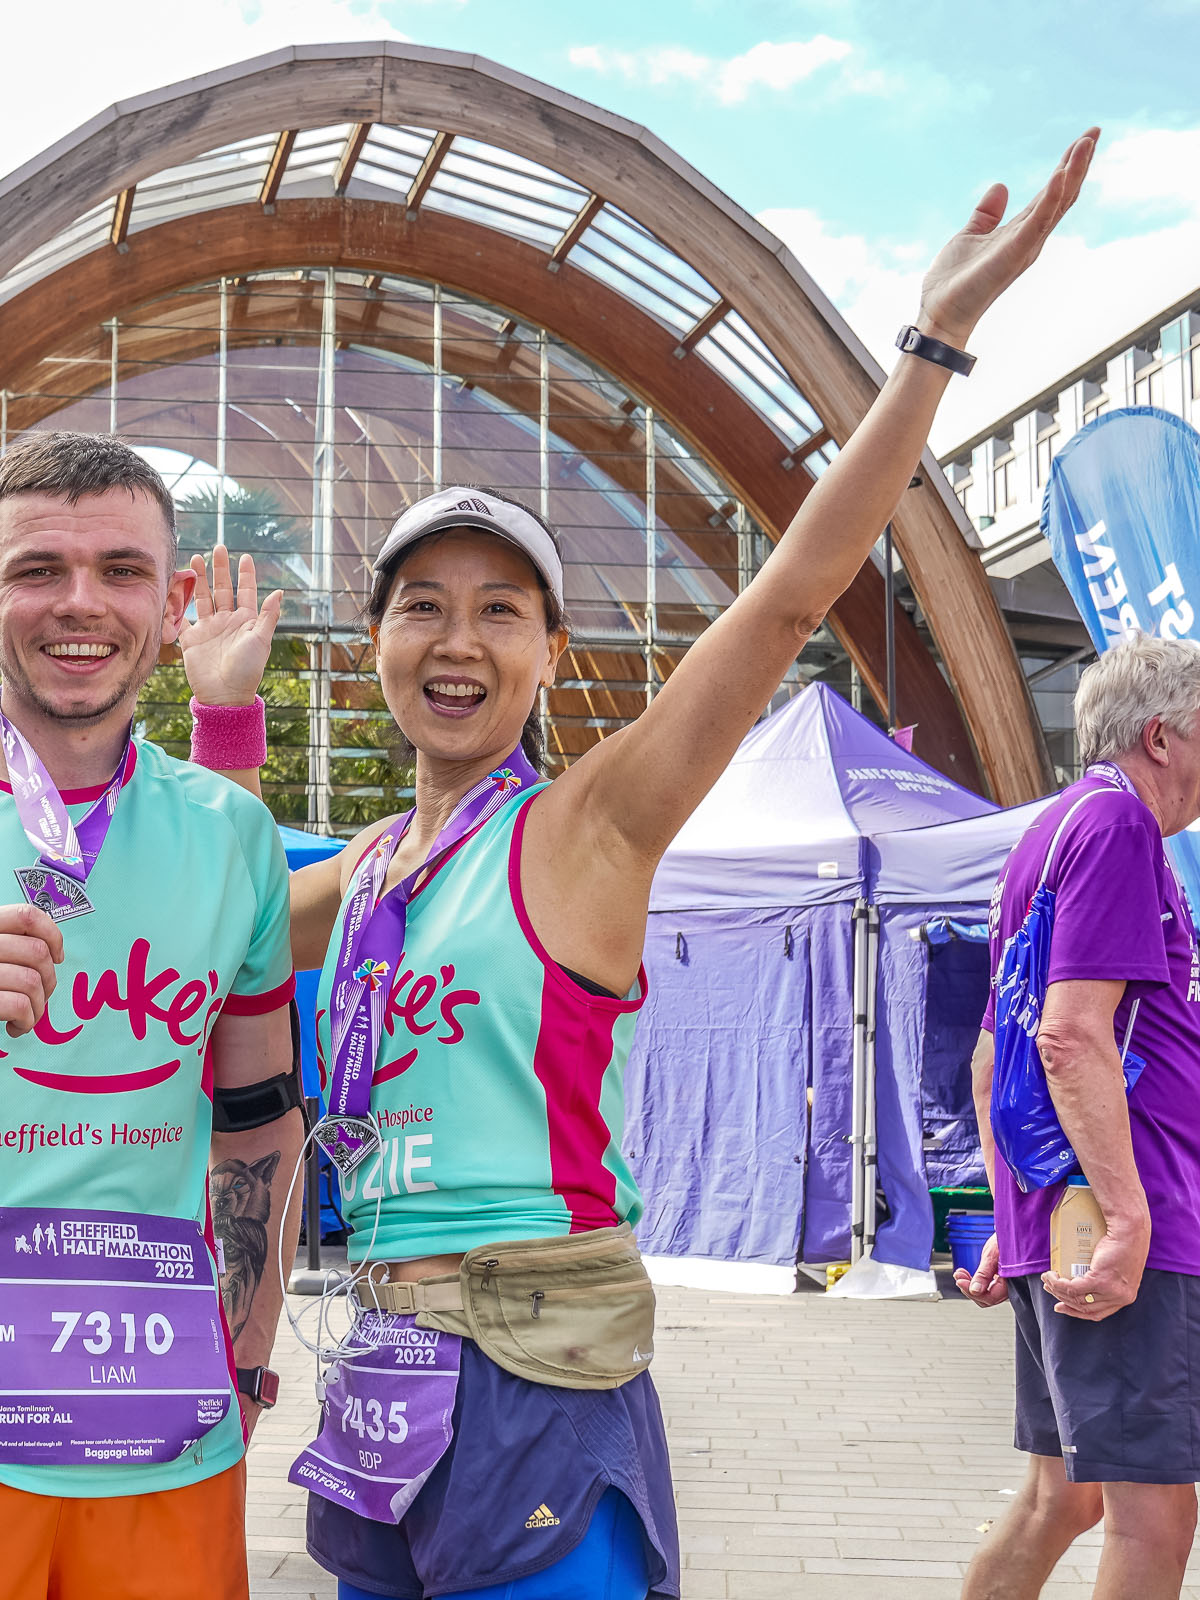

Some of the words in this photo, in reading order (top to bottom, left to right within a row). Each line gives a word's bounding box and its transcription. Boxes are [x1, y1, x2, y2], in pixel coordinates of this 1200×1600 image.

[351, 894, 362, 915] HALF
[354, 892, 369, 932] SHEFFIELD
[342, 917, 356, 968] MARATHON
[348, 1031, 359, 1058] HALF
[351, 1033, 367, 1080] SHEFFIELD
[338, 1056, 355, 1115] MARATHON
[377, 1103, 434, 1130] Hospice
[110, 1121, 183, 1151] Hospice
[63, 1222, 136, 1240] SHEFFIELD
[63, 1240, 104, 1256] HALF
[107, 1241, 191, 1260] MARATHON
[155, 1261, 195, 1279] 2022
[0, 1325, 15, 1342] M
[50, 1311, 175, 1355] 7310
[394, 1347, 436, 1365] 2022
[89, 1365, 137, 1384] LIAM
[197, 1399, 222, 1407] Sheffield
[27, 1413, 50, 1424] FOR
[52, 1412, 73, 1424] ALL
[341, 1394, 409, 1444] 7435
[84, 1448, 128, 1459] Baggage
[129, 1446, 153, 1457] label
[113, 1438, 127, 1446] along
[358, 1449, 382, 1470] BDP
[297, 1465, 320, 1482] RUN
[318, 1475, 338, 1490] FOR
[337, 1486, 357, 1500] ALL
[525, 1515, 560, 1529] adidas
